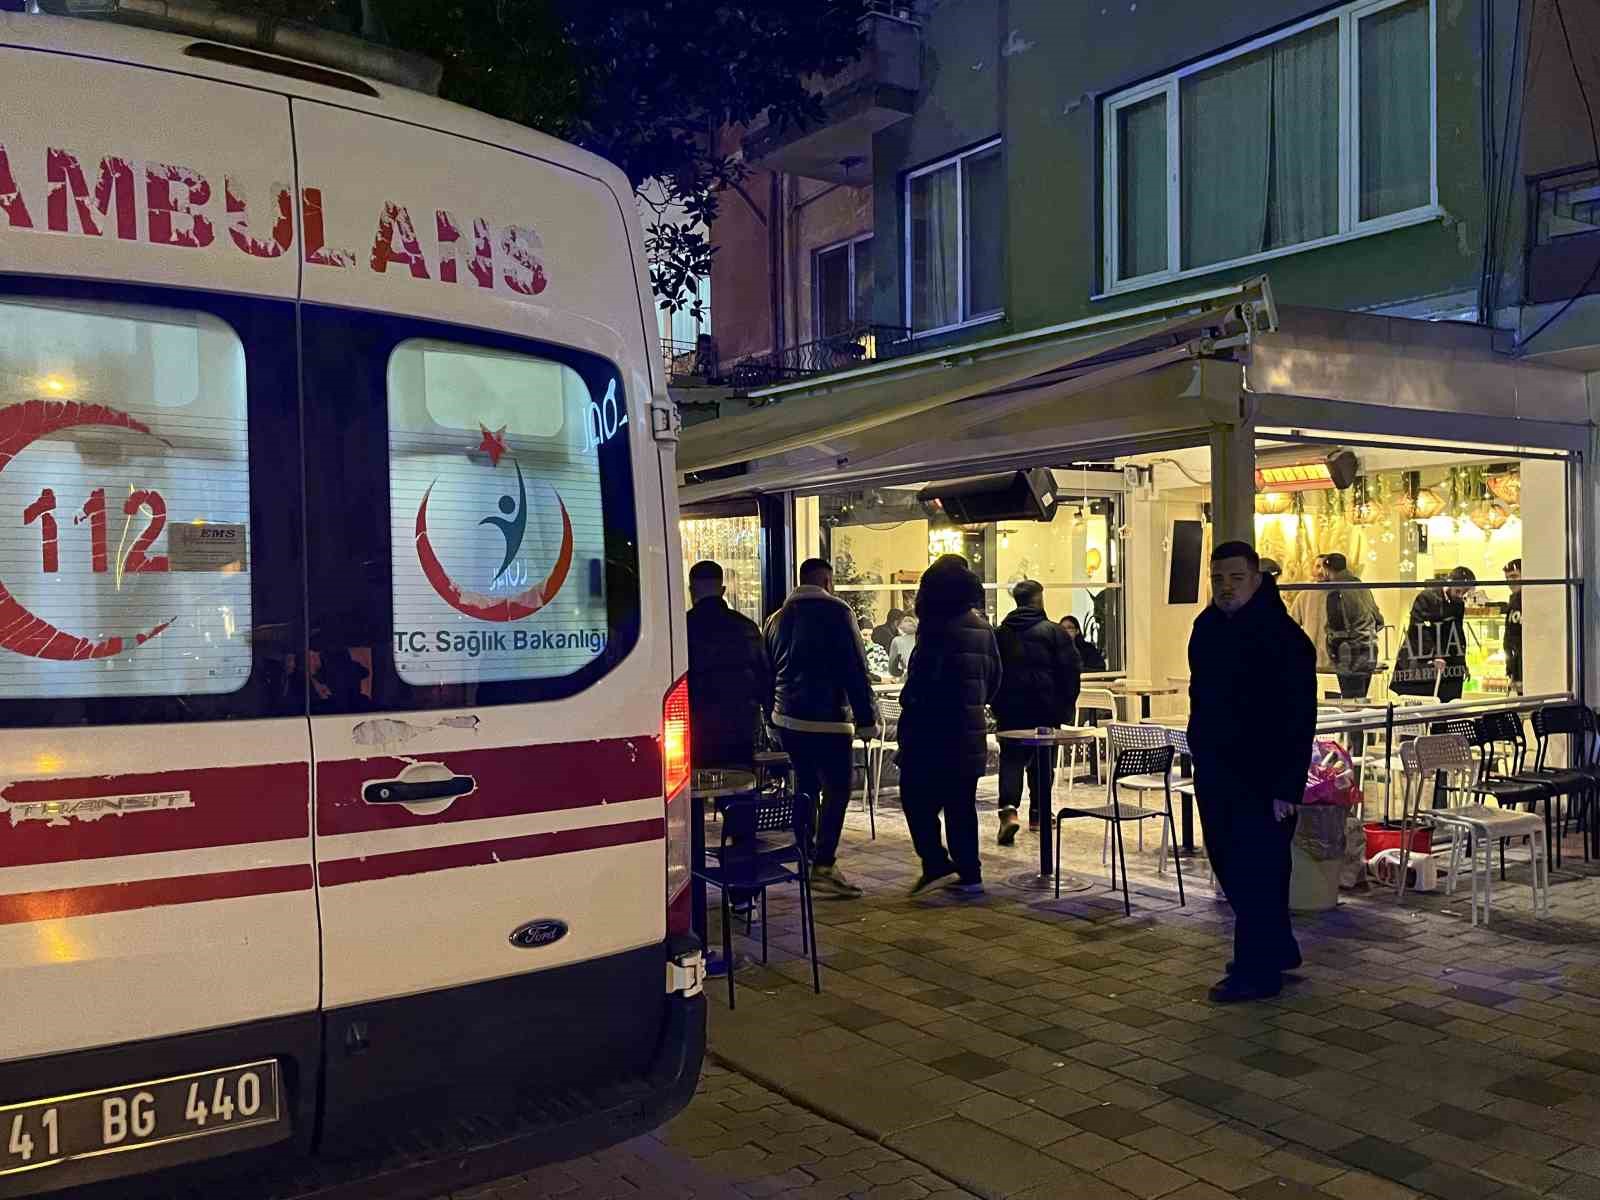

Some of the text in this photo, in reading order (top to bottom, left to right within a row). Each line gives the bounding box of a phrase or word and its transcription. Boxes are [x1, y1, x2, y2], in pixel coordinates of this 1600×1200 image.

[24, 487, 169, 573] 112
[393, 628, 608, 657] T.C. Sağlık Bakanlığı
[524, 925, 558, 944] Ford
[9, 1072, 260, 1160] 41 BG 440
